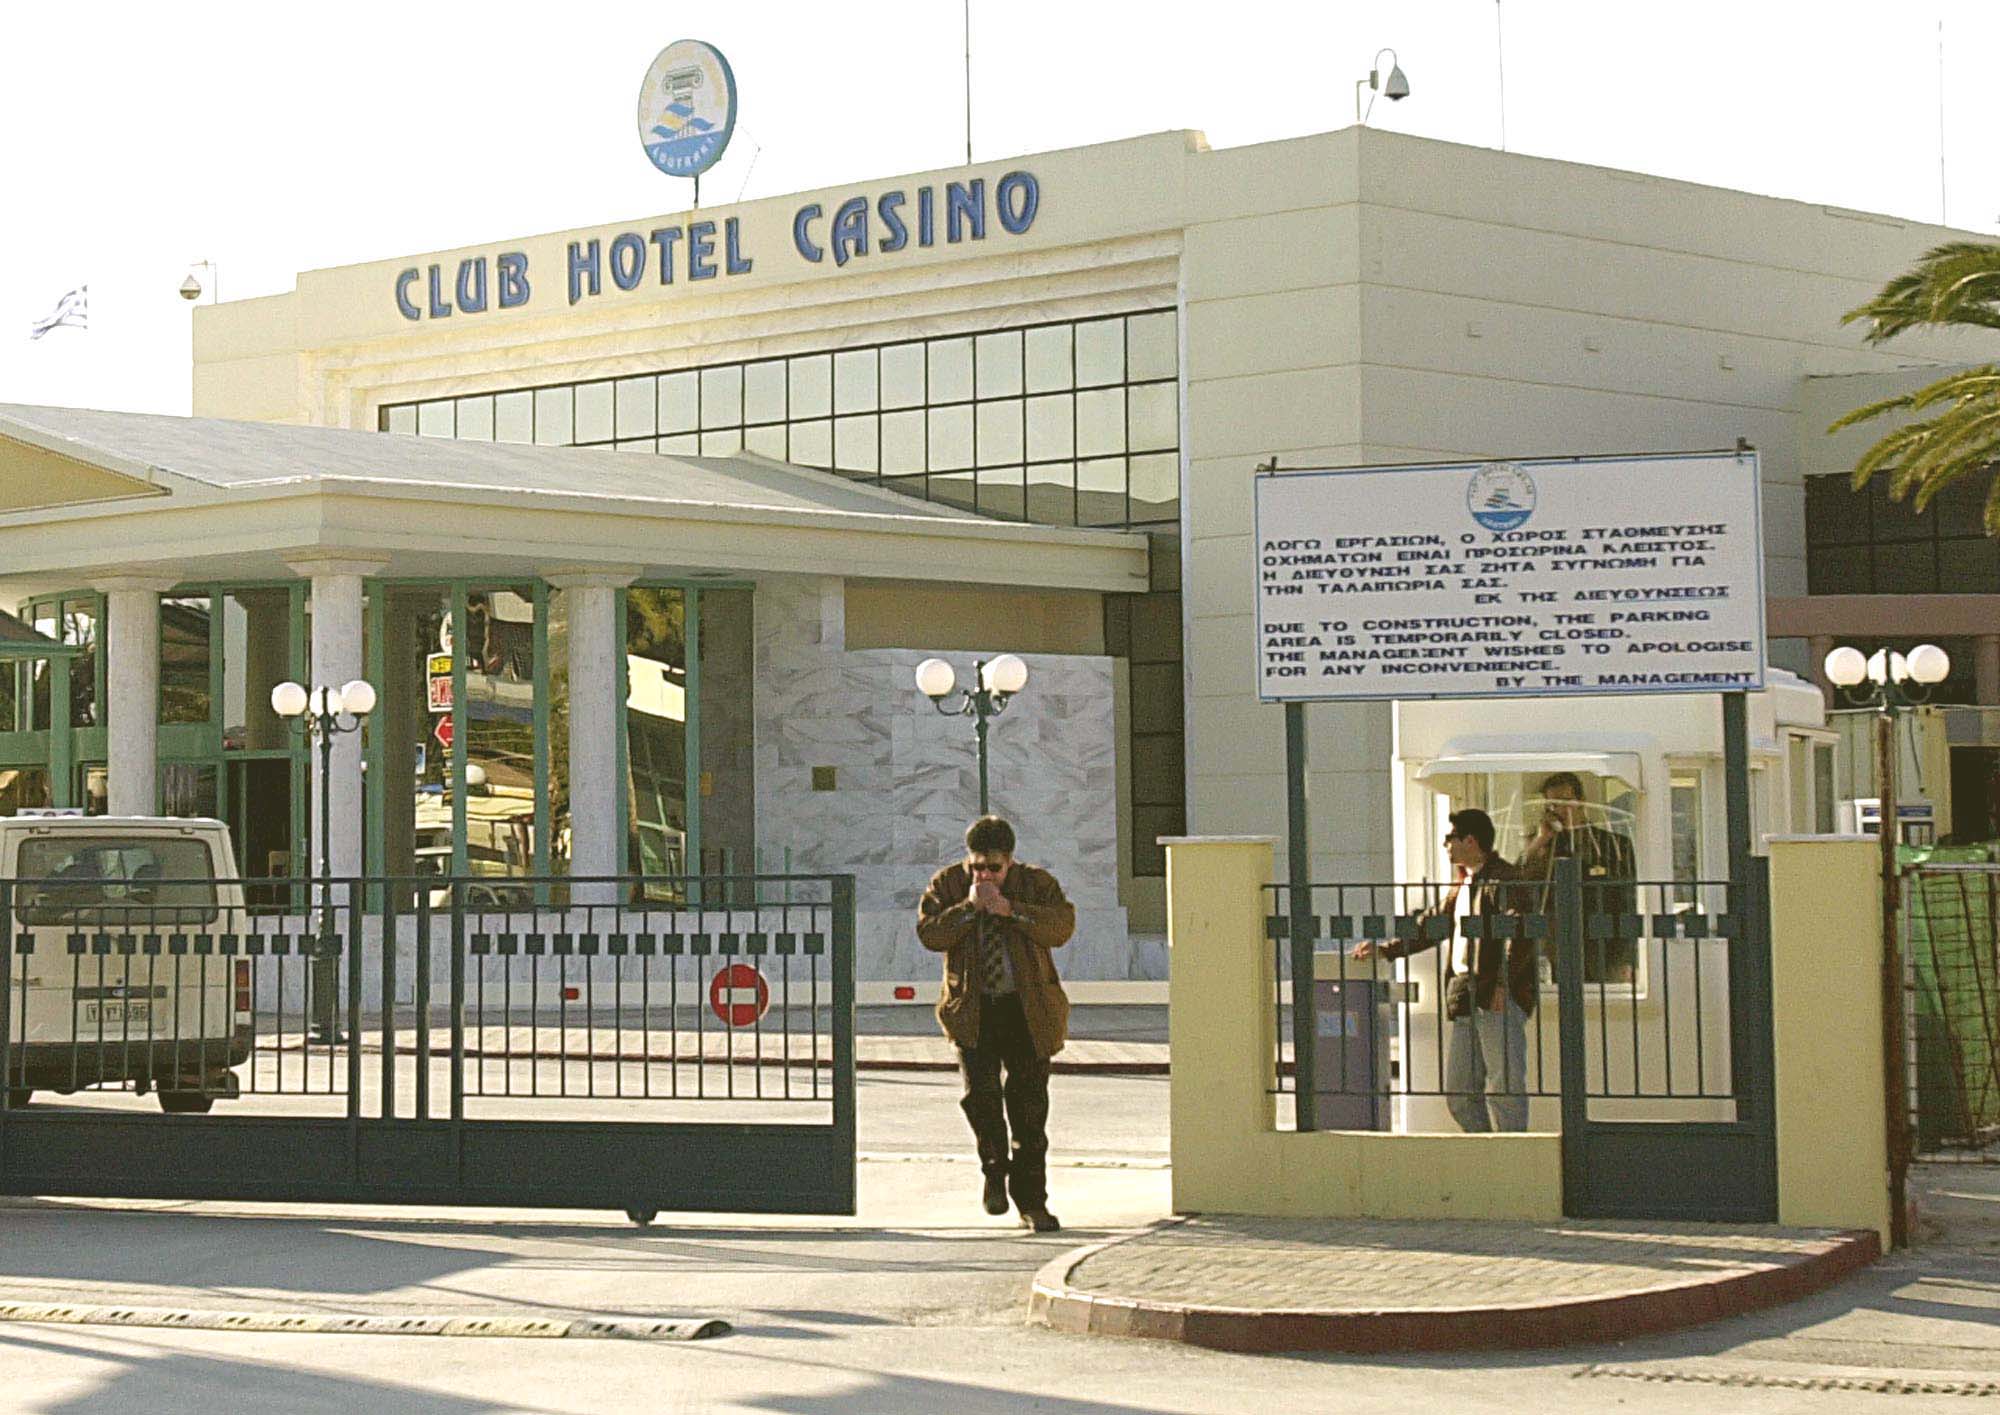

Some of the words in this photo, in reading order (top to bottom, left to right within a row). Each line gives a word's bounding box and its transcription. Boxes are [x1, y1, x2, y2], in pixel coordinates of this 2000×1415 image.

[396, 253, 529, 320] CLUB
[568, 217, 752, 305] HOTEL
[793, 171, 1039, 267] CASINO
[1264, 540, 1321, 551] ΛΟΓΩ
[1493, 531, 1567, 542] ΧΩΡΟΣ
[1263, 553, 1382, 566] ΟΧΗΜΑΤΩΝ
[1397, 550, 1450, 561] ΕΙΝΑΙ
[1465, 546, 1587, 558] ΠΡΟΣΩΡΙΝΑ
[1603, 540, 1715, 553] ΚΛΕΙΣΤΟΣ.
[1293, 567, 1411, 579] ΔΙΕΥΘΥΝΣΗ
[1425, 564, 1465, 575] ΣΑΣ
[1552, 558, 1656, 570] ΣΥΓΝΩΜΗ
[1672, 556, 1705, 566] ΓΙΑ
[1264, 585, 1302, 595] ΤΗΝ
[1319, 581, 1445, 593] ΤΑΛΑΙΠΩΡΙΑ
[1519, 592, 1558, 602] ΤΗΣ
[1574, 586, 1729, 601] ΔΙΕΥΘΥΝΣΕΩΣ
[1264, 623, 1304, 633] DUE
[1319, 621, 1348, 631] TO
[1363, 615, 1537, 630] CONSTRUCTION,
[1554, 614, 1594, 624] THE
[1610, 610, 1710, 622] PARKING
[1266, 637, 1322, 647] AREA
[1337, 635, 1355, 645] IS
[1372, 631, 1522, 644] TEMPORARILY
[1539, 629, 1631, 640] CLOSED.
[1267, 652, 1304, 662] THE
[1320, 647, 1468, 660] MANAGEMENT
[1484, 645, 1566, 656] WISHES
[1581, 644, 1610, 654] TO
[1628, 641, 1752, 653] APOLOGISE
[1266, 667, 1306, 677] FOR
[1322, 664, 1366, 675] ANY
[1382, 660, 1560, 674] INCONVENIENCE.
[1496, 676, 1524, 687] BY
[1541, 675, 1583, 686] THE
[1598, 672, 1754, 685] MANAGEMENT
